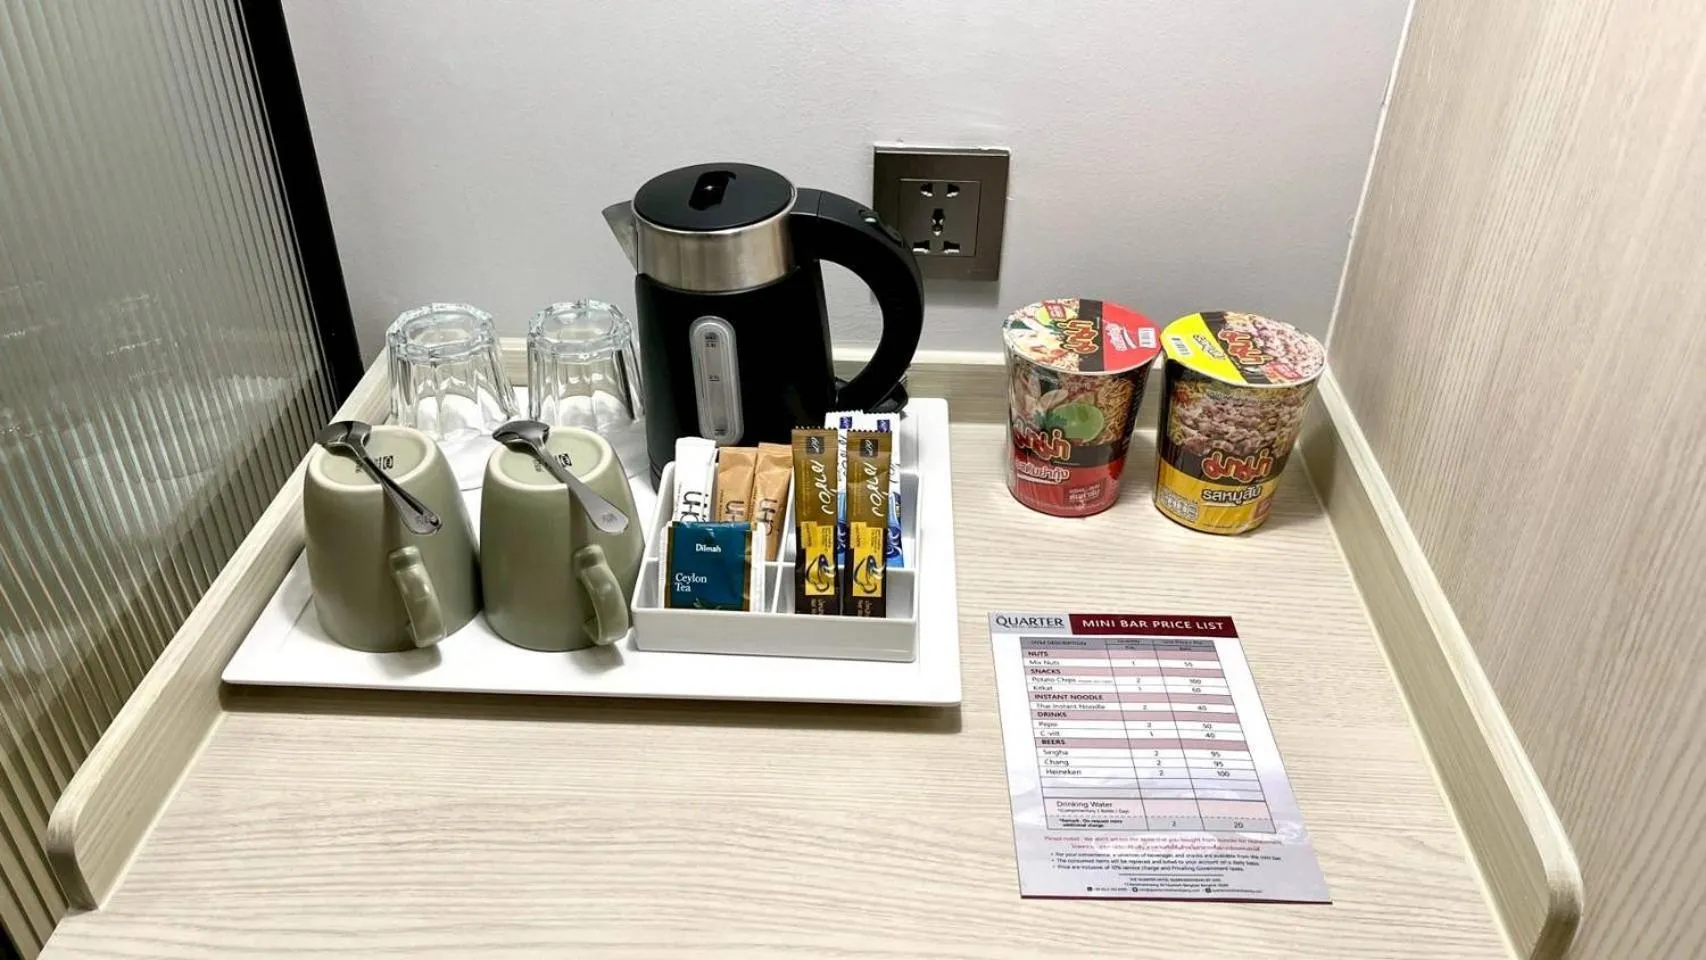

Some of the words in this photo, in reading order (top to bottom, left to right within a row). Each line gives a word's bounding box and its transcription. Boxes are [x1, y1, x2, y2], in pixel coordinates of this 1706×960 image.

[695, 543, 721, 553] Dilmah
[675, 572, 707, 585] Ceylon
[674, 583, 691, 592] Tea
[995, 614, 1065, 628] QUARTER
[1082, 618, 1115, 628] MINI
[1120, 619, 1148, 629] BAR
[1153, 620, 1192, 630] PRICE
[1196, 621, 1223, 631] LIST
[1043, 749, 1069, 757] Singha
[1044, 759, 1069, 767] Chang
[1046, 768, 1082, 776] Heineken
[1056, 801, 1089, 809] Drinking
[1233, 821, 1244, 829] 20
